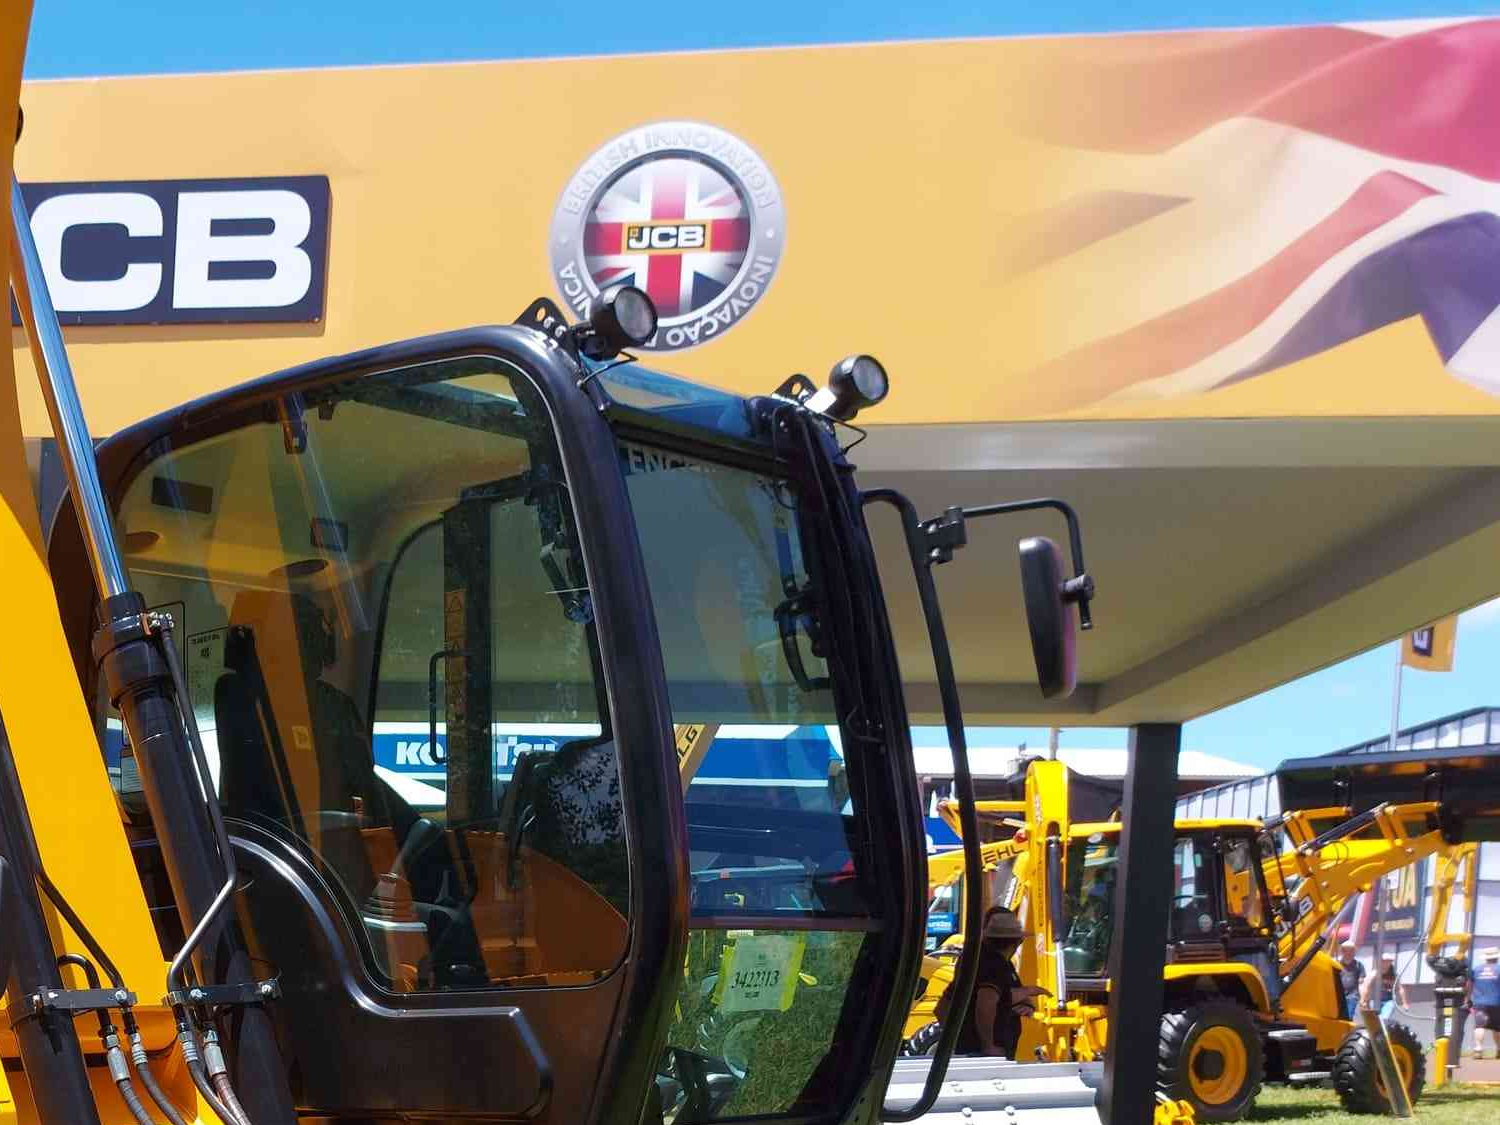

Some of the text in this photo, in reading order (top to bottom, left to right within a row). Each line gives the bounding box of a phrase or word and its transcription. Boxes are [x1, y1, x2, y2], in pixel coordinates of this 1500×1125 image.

[563, 126, 777, 216] BRITISH INNOVATION
[29, 189, 312, 312] CB
[627, 225, 706, 249] JCB
[665, 254, 774, 346] INOVAÇÃO
